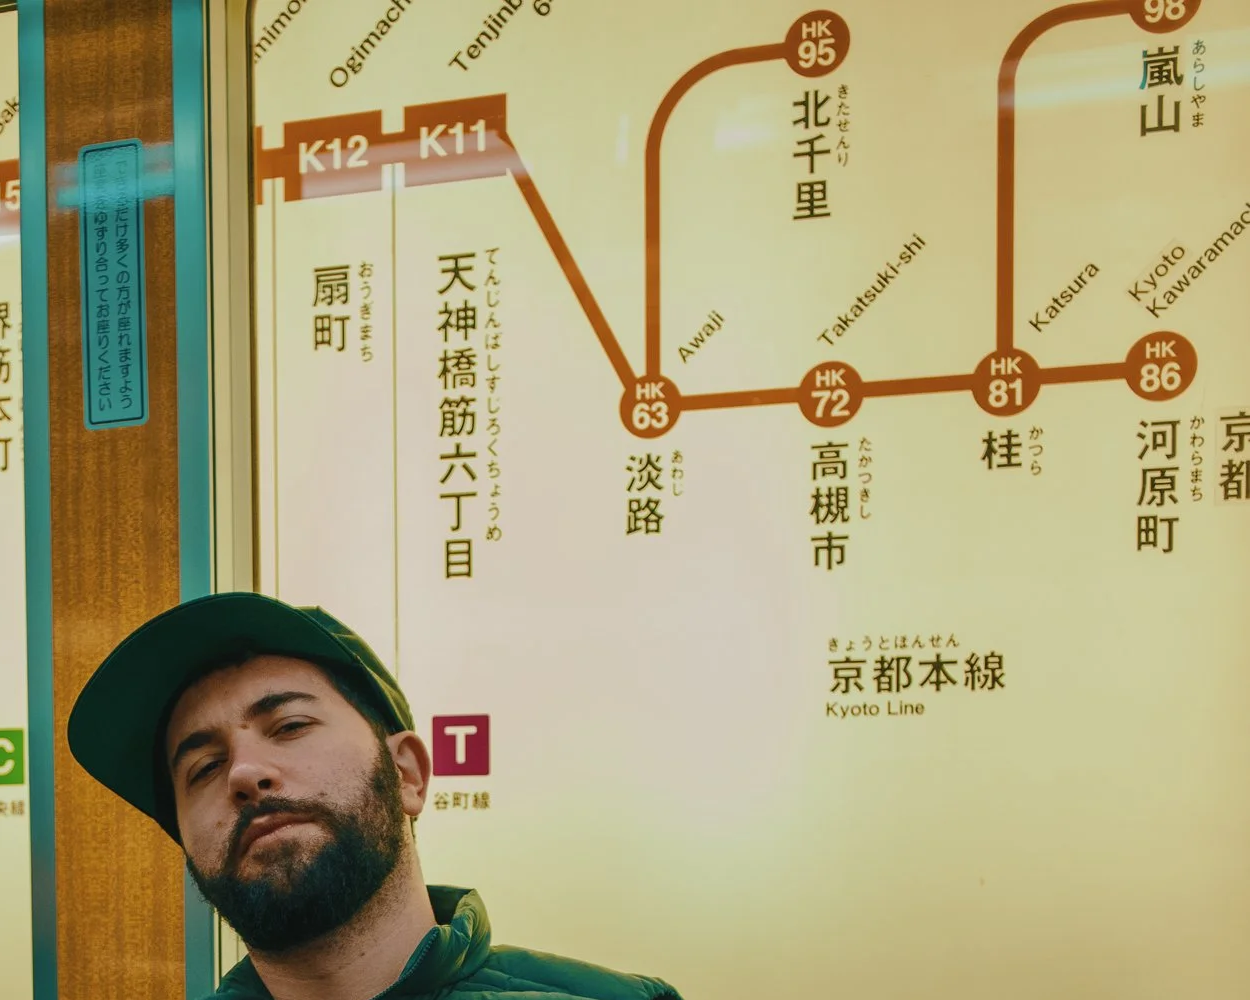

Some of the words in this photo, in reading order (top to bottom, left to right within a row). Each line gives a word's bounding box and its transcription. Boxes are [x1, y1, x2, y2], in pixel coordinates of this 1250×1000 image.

[533, 0, 553, 16] 6
[802, 19, 832, 39] HK
[1144, 0, 1186, 23] 98
[798, 38, 836, 69] 95
[1139, 45, 1184, 137] 嵐山
[1191, 39, 1206, 127] あらしやま
[419, 119, 486, 159] K11
[836, 83, 850, 168] きたせんり
[299, 134, 369, 174] K12
[792, 89, 832, 220] 北千里
[1127, 246, 1185, 302] Kyoto
[1145, 202, 1250, 319] Kawaramac
[312, 264, 351, 352] 扇町
[358, 260, 374, 363] おうぎまち
[817, 233, 926, 345] Takatsuki-shi
[1028, 261, 1100, 333] Katsura
[677, 309, 725, 364] Awaji
[1145, 340, 1176, 359] HK
[815, 368, 847, 387] HK
[990, 356, 1022, 376] HK
[1139, 362, 1181, 393] 86
[635, 381, 665, 400] HK
[810, 389, 850, 418] 72
[988, 377, 1023, 408] 81
[437, 252, 478, 579] 天神橋筋六丁目
[632, 401, 669, 429] 63
[980, 429, 1023, 470] 桂
[1028, 425, 1044, 476] かつら
[1189, 415, 1205, 502] かわらまち
[1219, 411, 1250, 500] 京都
[625, 452, 664, 536] 淡路
[670, 450, 684, 497] あわじ
[857, 437, 872, 520] たかつきし
[1136, 418, 1181, 553] 河原町
[809, 441, 850, 571] 高槻市
[827, 633, 960, 652] きょうとほんせん
[828, 650, 1006, 694] 京都本線
[825, 701, 880, 719] Kyoto
[887, 700, 925, 716] Line
[444, 725, 477, 764] T
[433, 791, 490, 810] 谷町線
